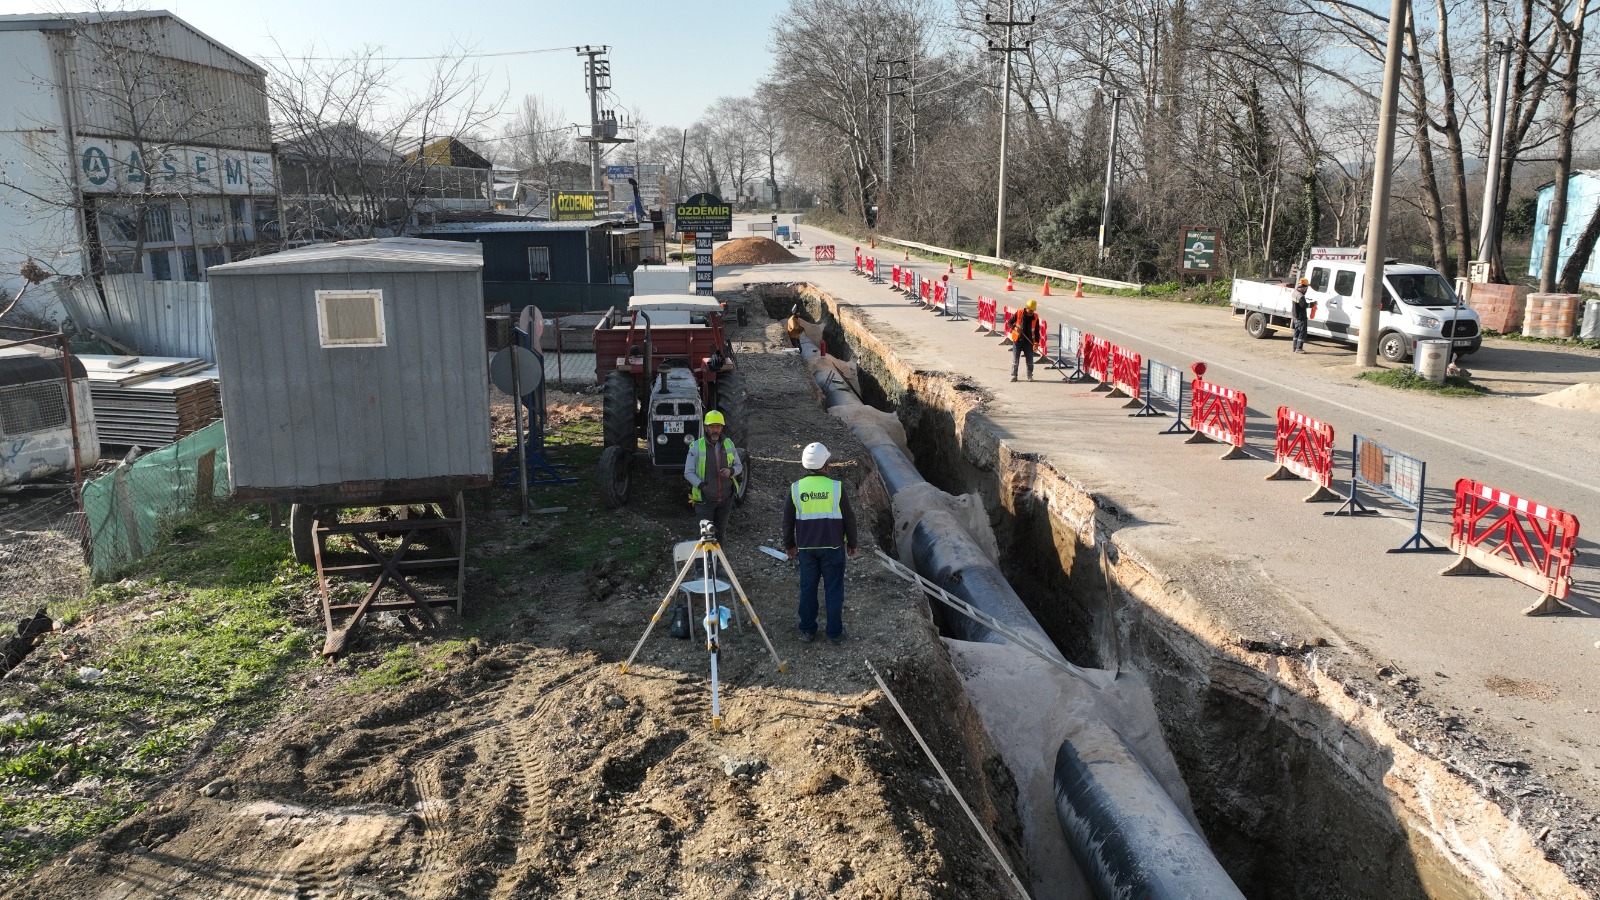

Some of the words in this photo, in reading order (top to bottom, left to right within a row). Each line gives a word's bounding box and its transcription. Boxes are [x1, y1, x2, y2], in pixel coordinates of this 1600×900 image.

[128, 151, 243, 185] ASEM
[558, 191, 594, 211] ÖZDEMİR
[677, 205, 729, 216] ÖZDEMİR
[696, 239, 711, 248] TARLA
[697, 256, 711, 264] ARSA
